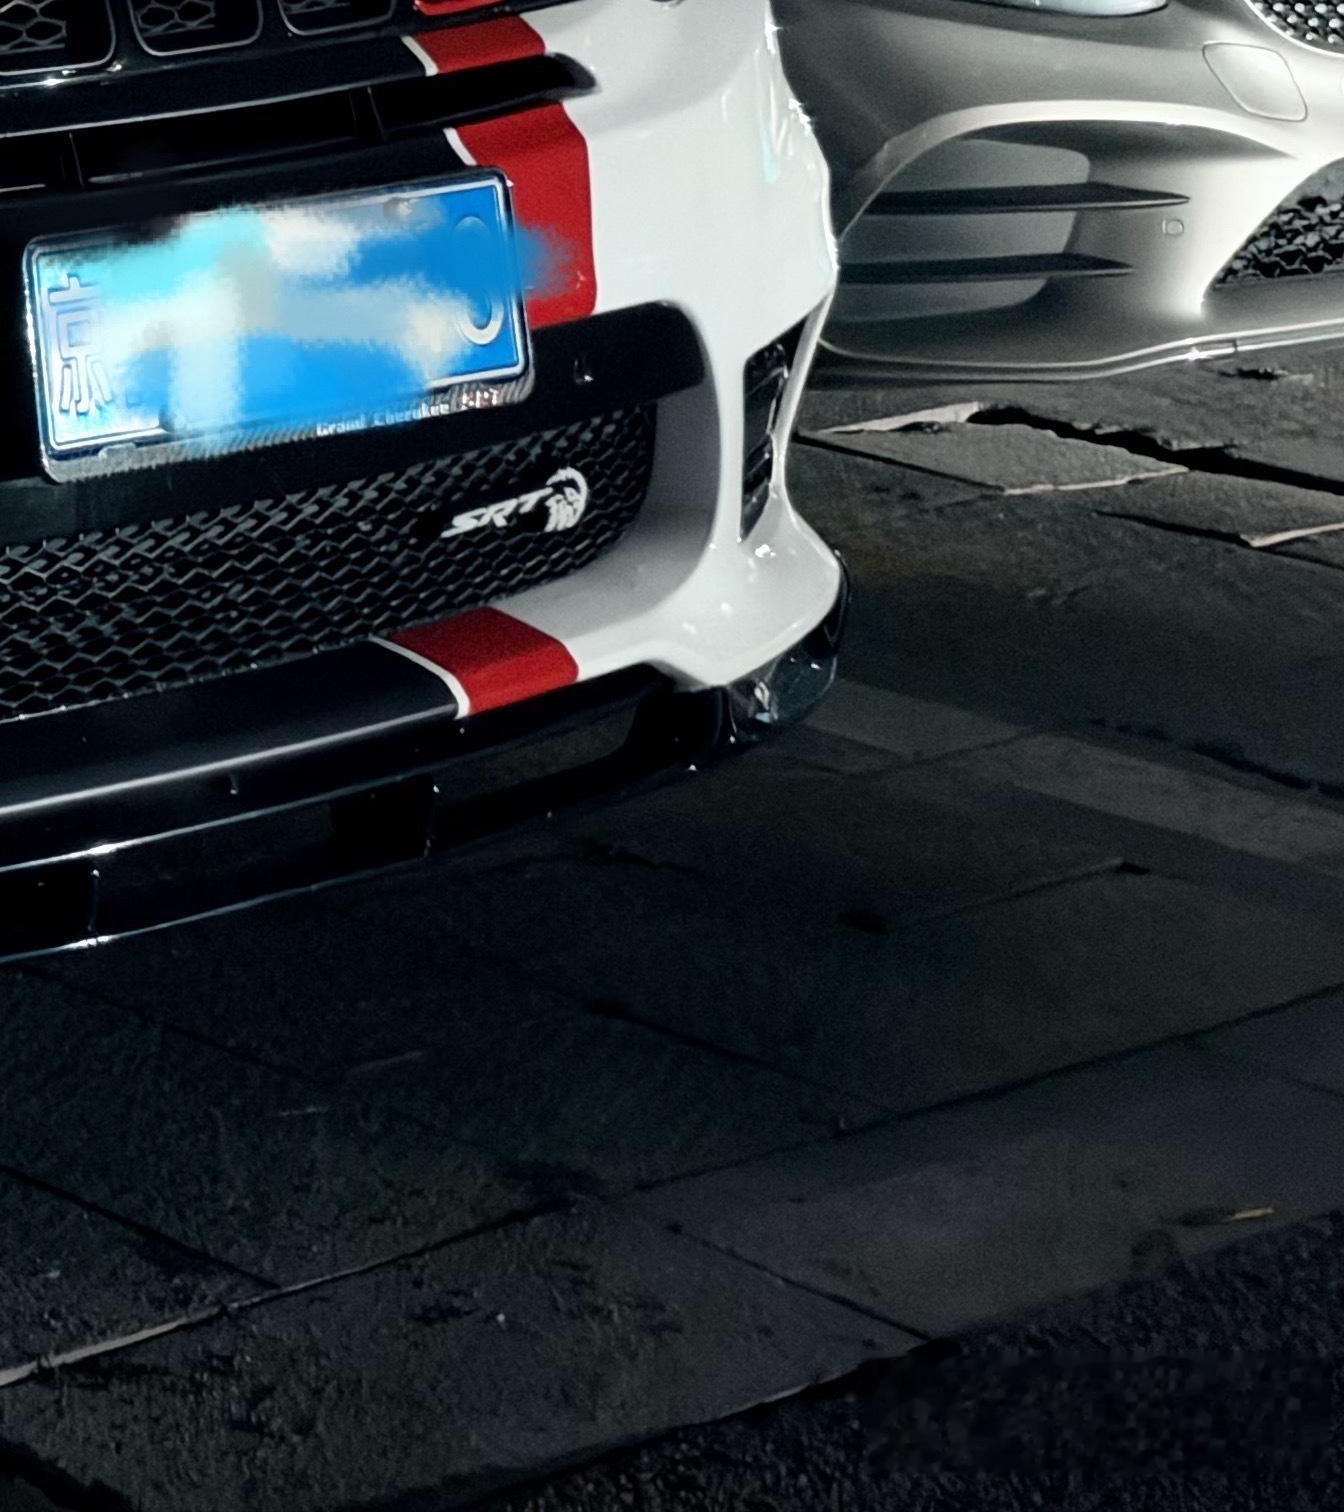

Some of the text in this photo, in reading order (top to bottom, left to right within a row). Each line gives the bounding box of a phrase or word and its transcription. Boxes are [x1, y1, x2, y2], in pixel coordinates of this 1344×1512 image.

[316, 413, 366, 438] Grand
[374, 402, 450, 427] Cherokee
[439, 486, 555, 539] SRT
